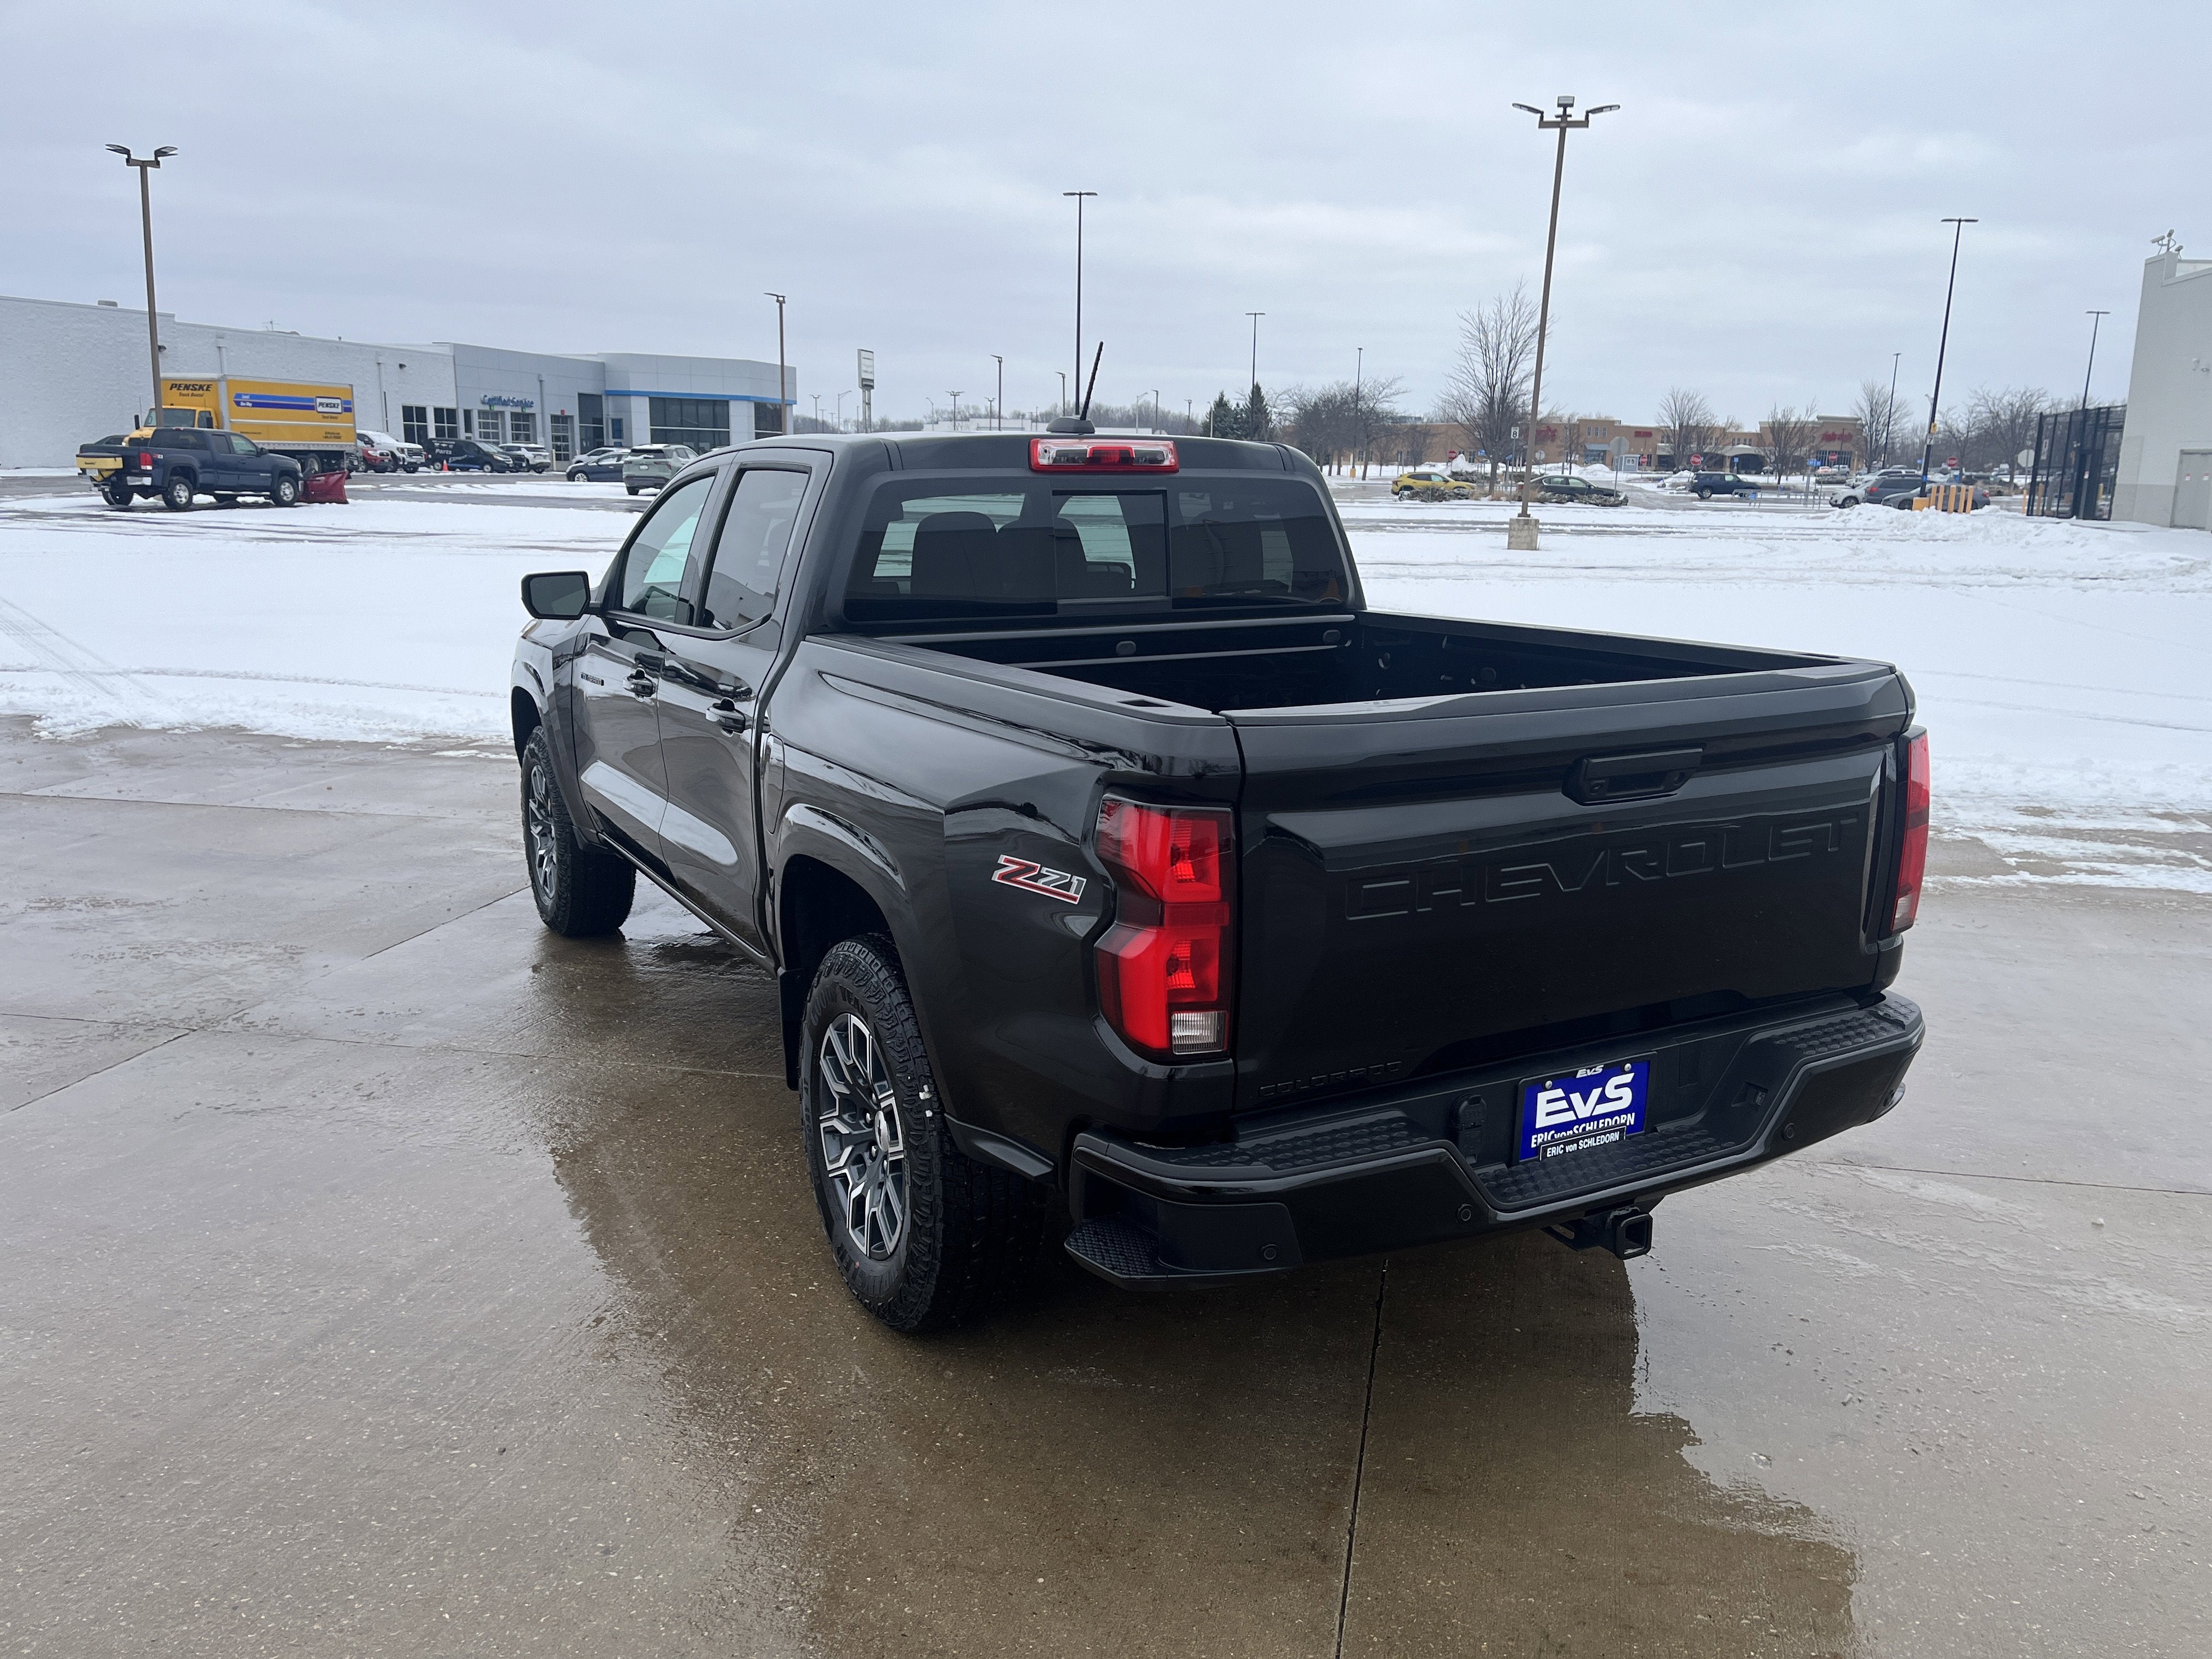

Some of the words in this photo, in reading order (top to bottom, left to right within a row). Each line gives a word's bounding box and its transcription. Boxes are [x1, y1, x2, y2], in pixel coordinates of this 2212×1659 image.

[170, 383, 212, 391] PENSKE
[991, 854, 1087, 905] Z71
[1346, 815, 1859, 921] CHEVROLET
[1259, 1061, 1402, 1098] COLORADO
[1536, 1073, 1635, 1128] EvS
[1547, 1144, 1564, 1158] ERIC
[1565, 1143, 1577, 1153] von
[1578, 1131, 1620, 1150] SCHLEDORN
